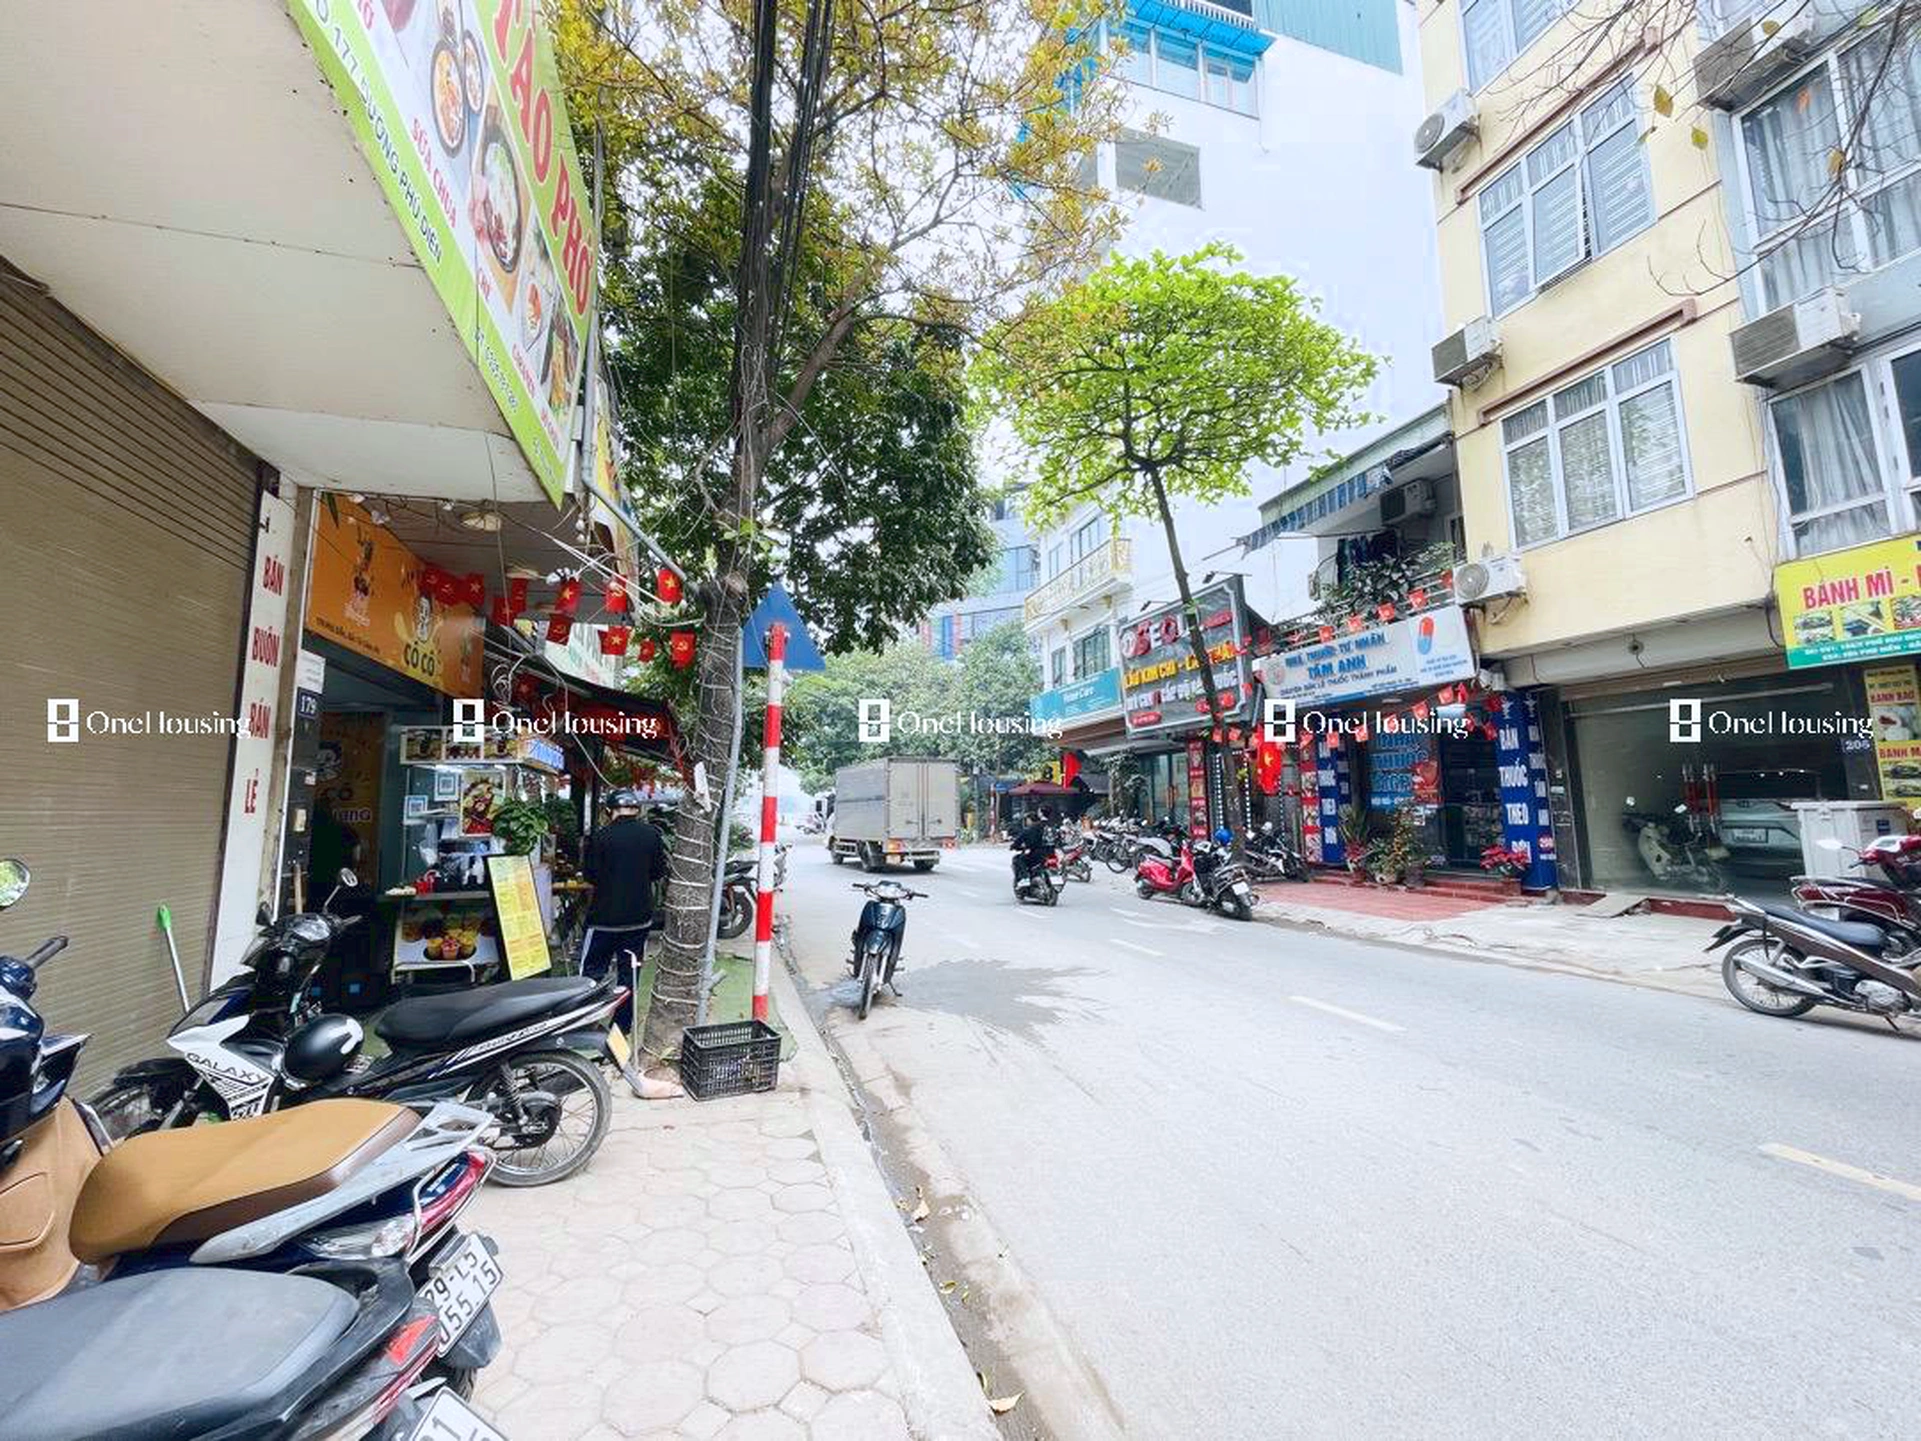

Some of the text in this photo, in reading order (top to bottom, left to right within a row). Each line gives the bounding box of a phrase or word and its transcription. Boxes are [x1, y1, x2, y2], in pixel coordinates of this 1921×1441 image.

[262, 554, 286, 597] BÁN
[1802, 577, 1860, 610] BÁNH
[252, 625, 281, 668] BUÔN
[1337, 653, 1367, 674] ANH
[249, 697, 272, 741] BÁN
[1499, 758, 1529, 788] THUỐC
[186, 1052, 270, 1082] GALAXY
